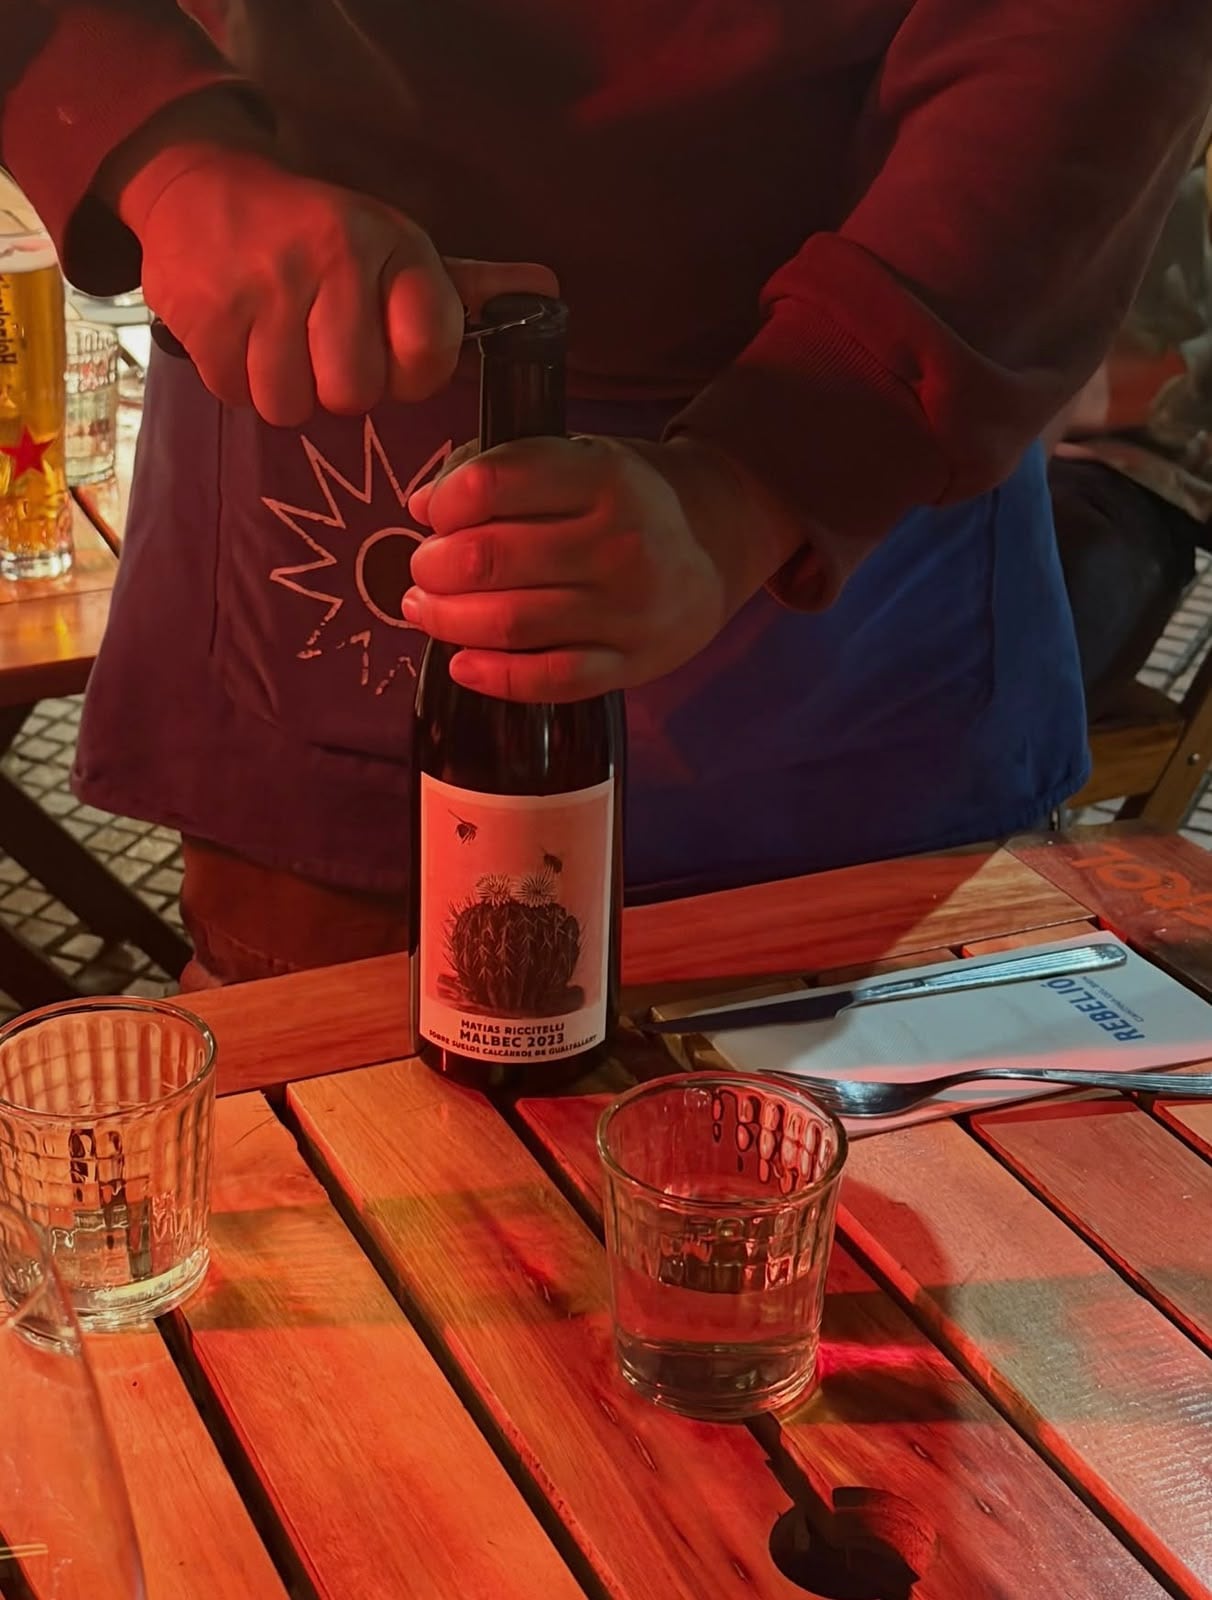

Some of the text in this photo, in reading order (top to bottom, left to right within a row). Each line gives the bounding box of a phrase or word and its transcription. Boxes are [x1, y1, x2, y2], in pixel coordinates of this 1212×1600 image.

[1040, 977, 1145, 1042] REBELIÓ
[461, 1019, 565, 1035] MATIAS RICCITELLI
[452, 1040, 480, 1054] SUELOS
[460, 1029, 564, 1048] MALBEC 2023
